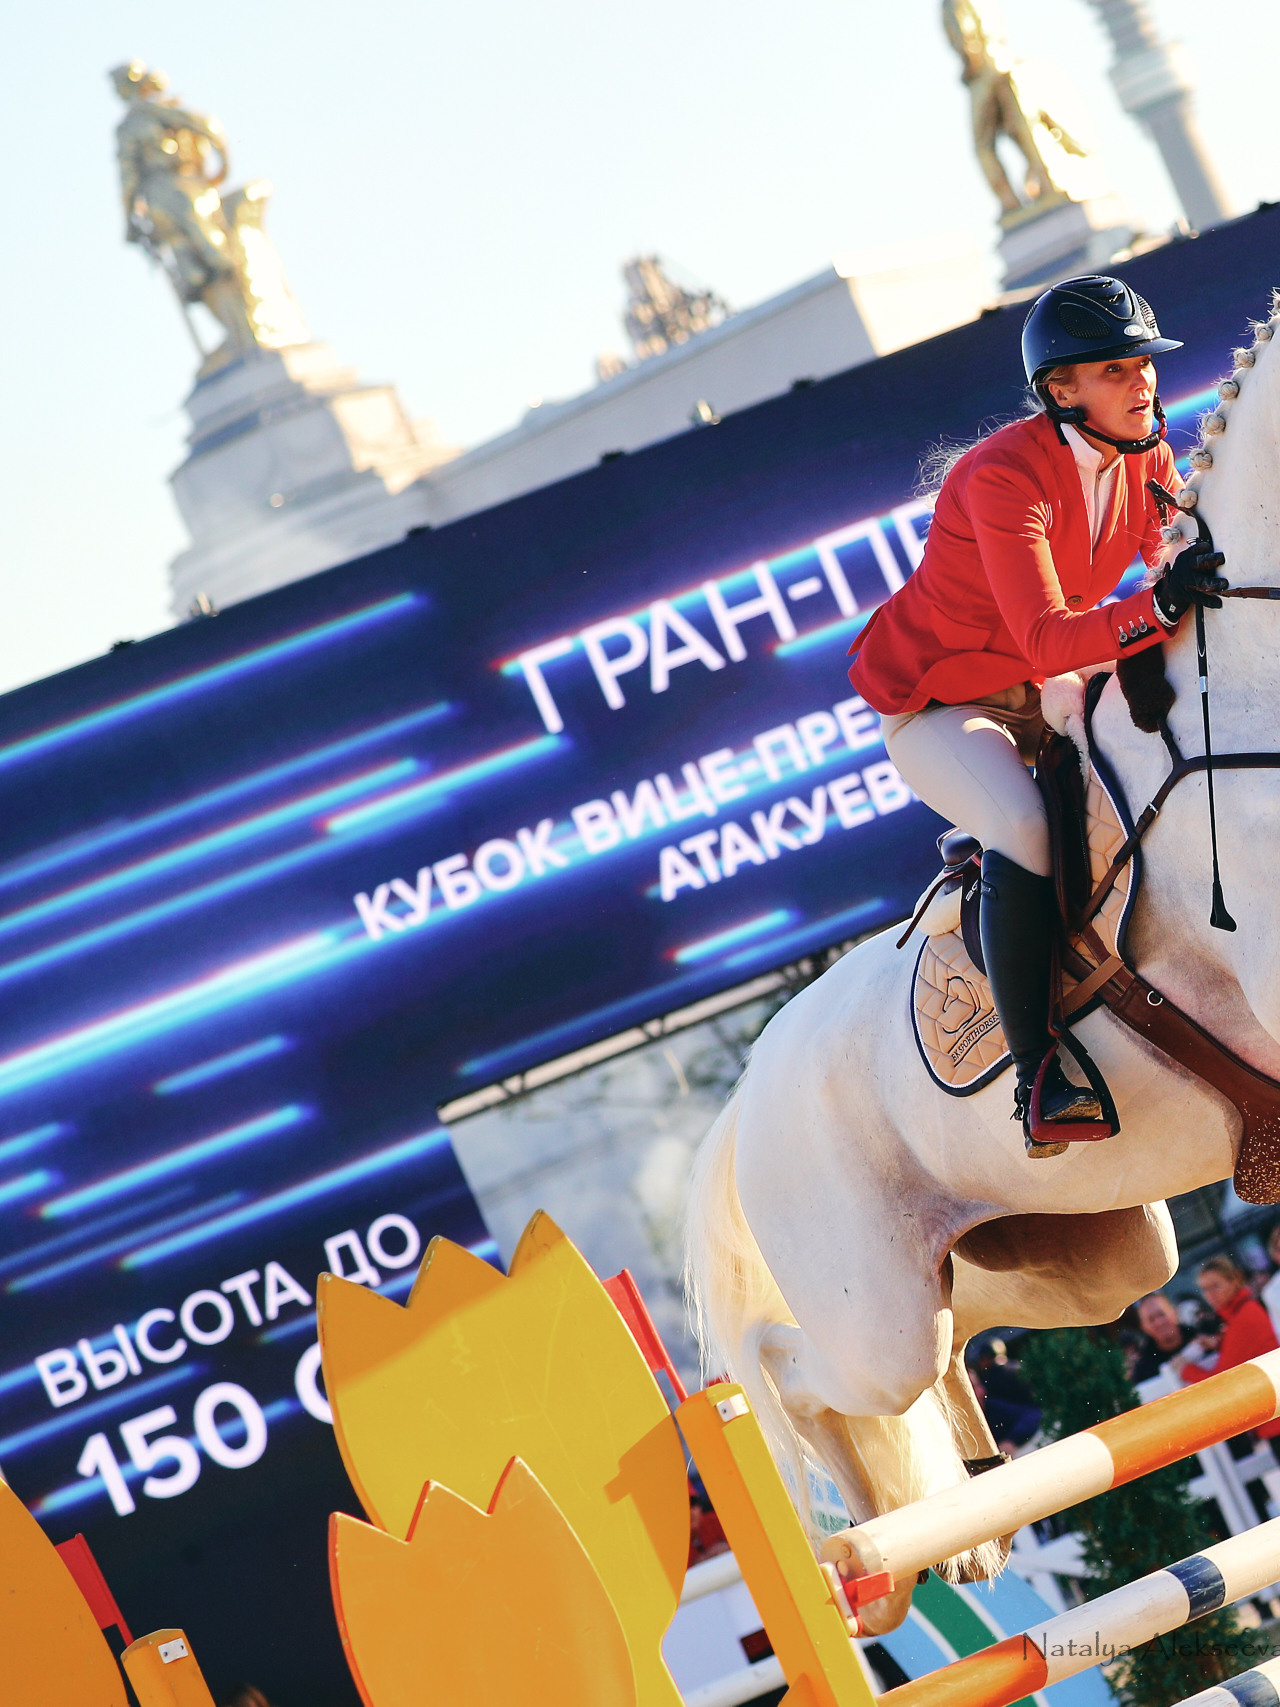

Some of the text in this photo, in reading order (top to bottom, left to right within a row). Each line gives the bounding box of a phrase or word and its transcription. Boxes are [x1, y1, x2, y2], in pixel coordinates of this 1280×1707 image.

[353, 694, 883, 942] КУБОК ВИЦЕ-ПРЕ
[655, 758, 918, 902] АТАКУЕВ
[34, 1213, 421, 1408] ВЫСОТА ДО
[76, 1381, 268, 1517] 150
